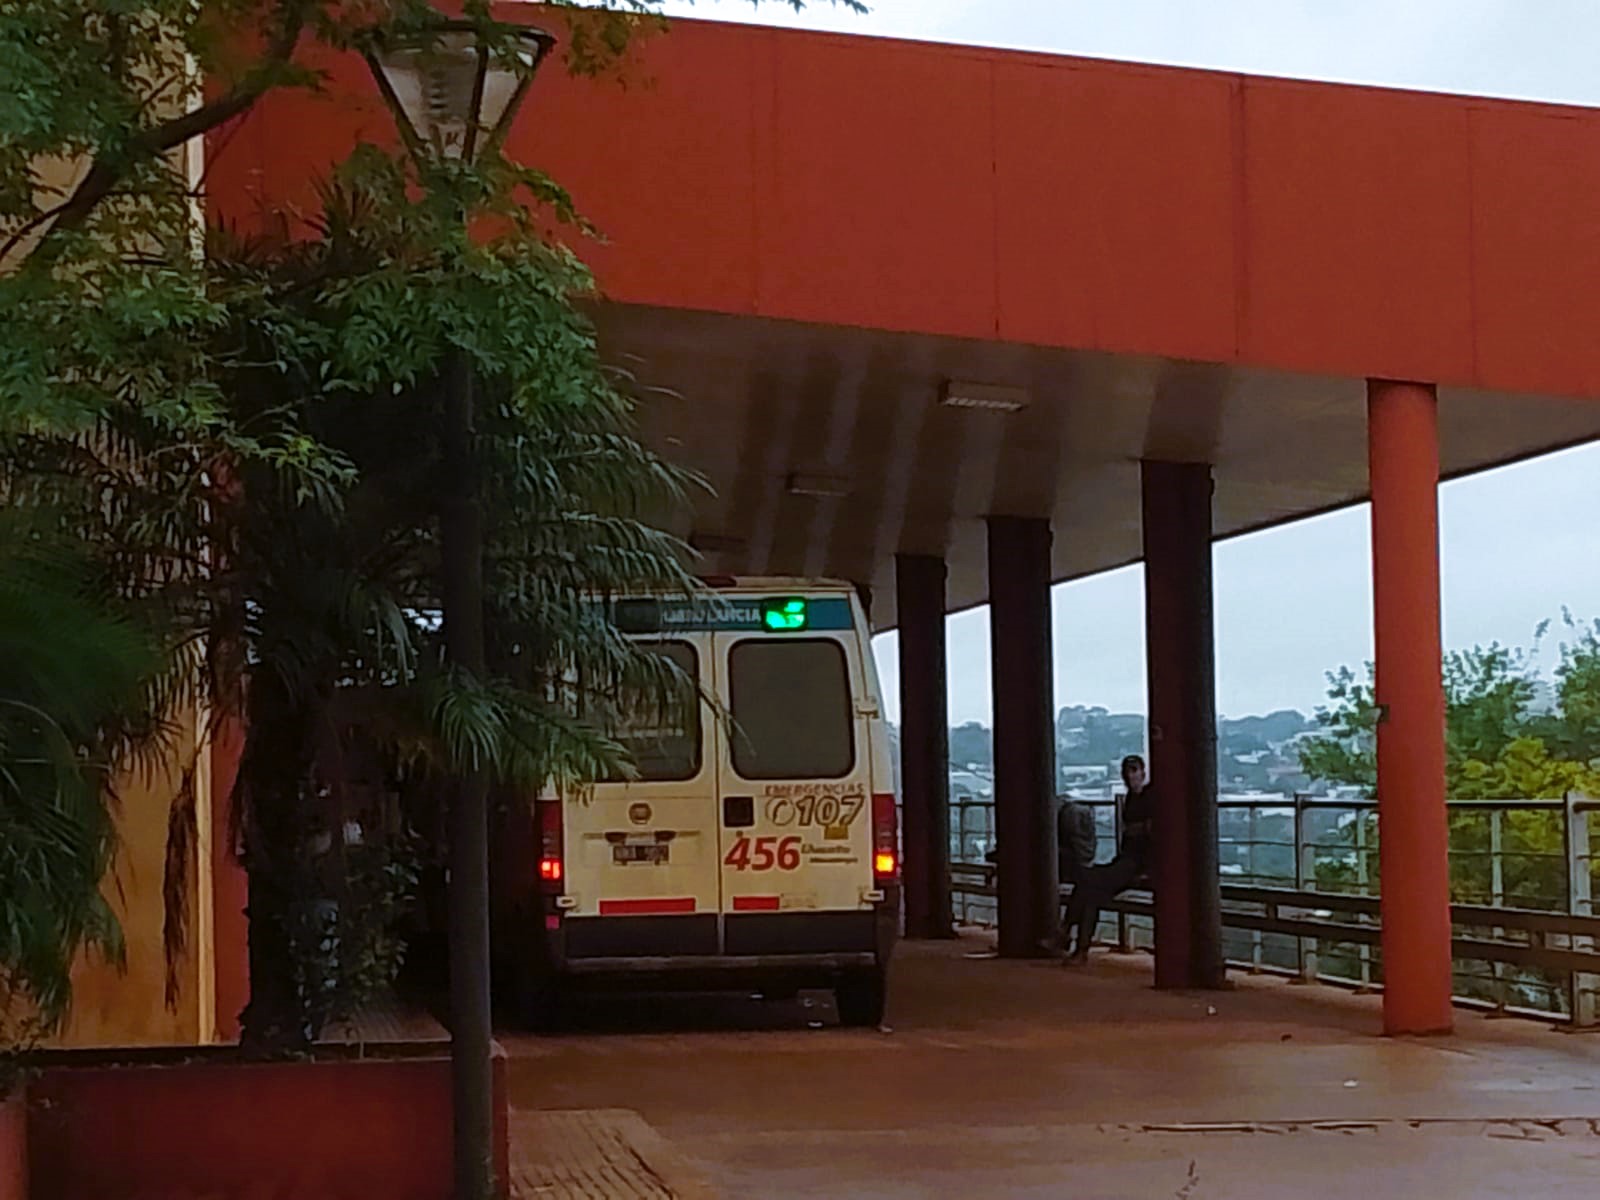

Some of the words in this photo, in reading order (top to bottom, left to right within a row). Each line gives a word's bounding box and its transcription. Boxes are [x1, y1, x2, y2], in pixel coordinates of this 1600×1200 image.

[765, 783, 865, 797] EMERGENCIAS
[796, 795, 865, 827] 107
[723, 836, 802, 871] 456
